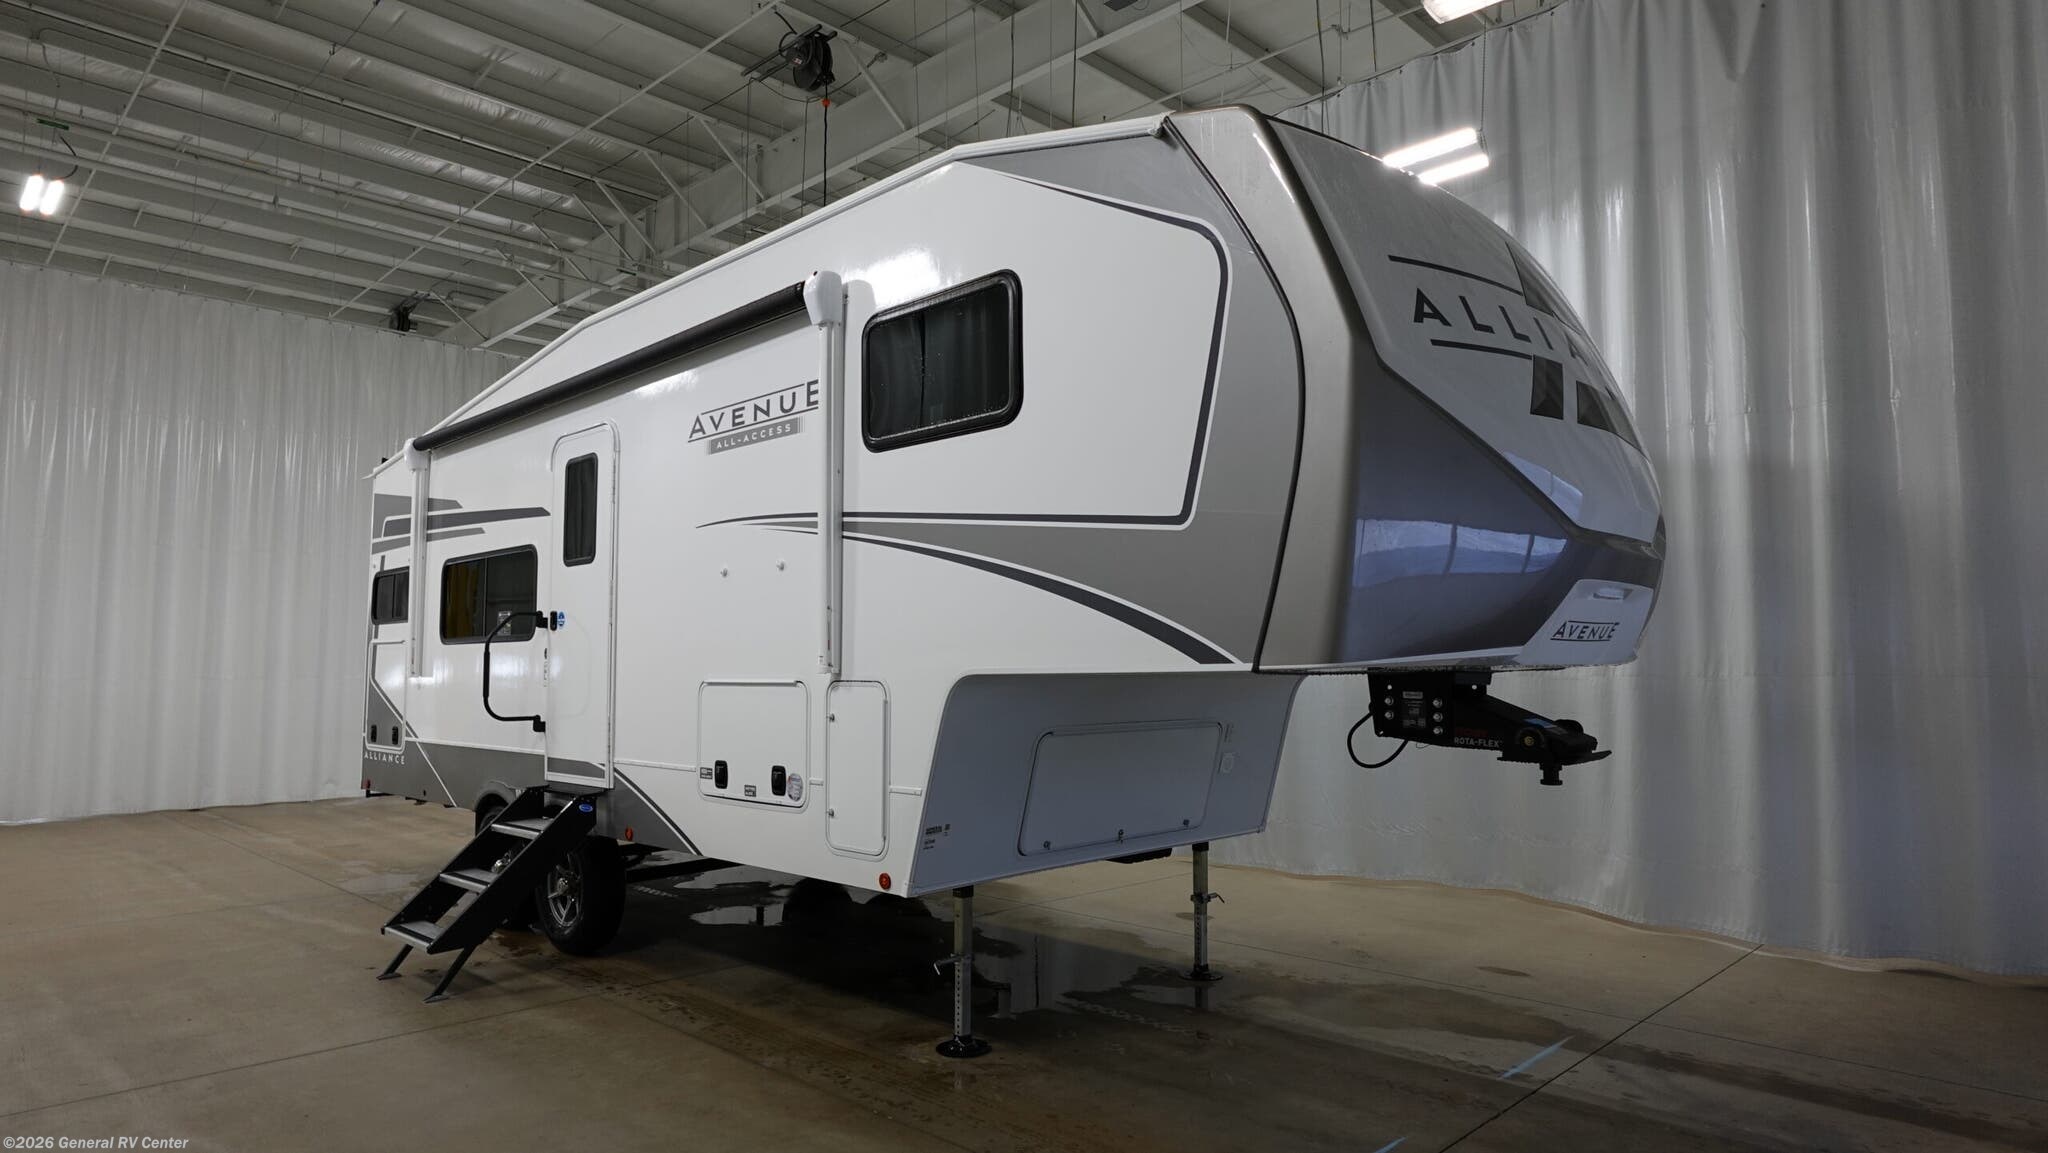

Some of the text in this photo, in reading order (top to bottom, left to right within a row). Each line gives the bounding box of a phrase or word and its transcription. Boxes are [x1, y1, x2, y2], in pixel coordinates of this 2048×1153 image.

[688, 379, 819, 440] AVENUE
[716, 423, 792, 449] ALL-ACCESS
[1552, 621, 1620, 639] AVENUE
[364, 751, 405, 765] ALLIANCE
